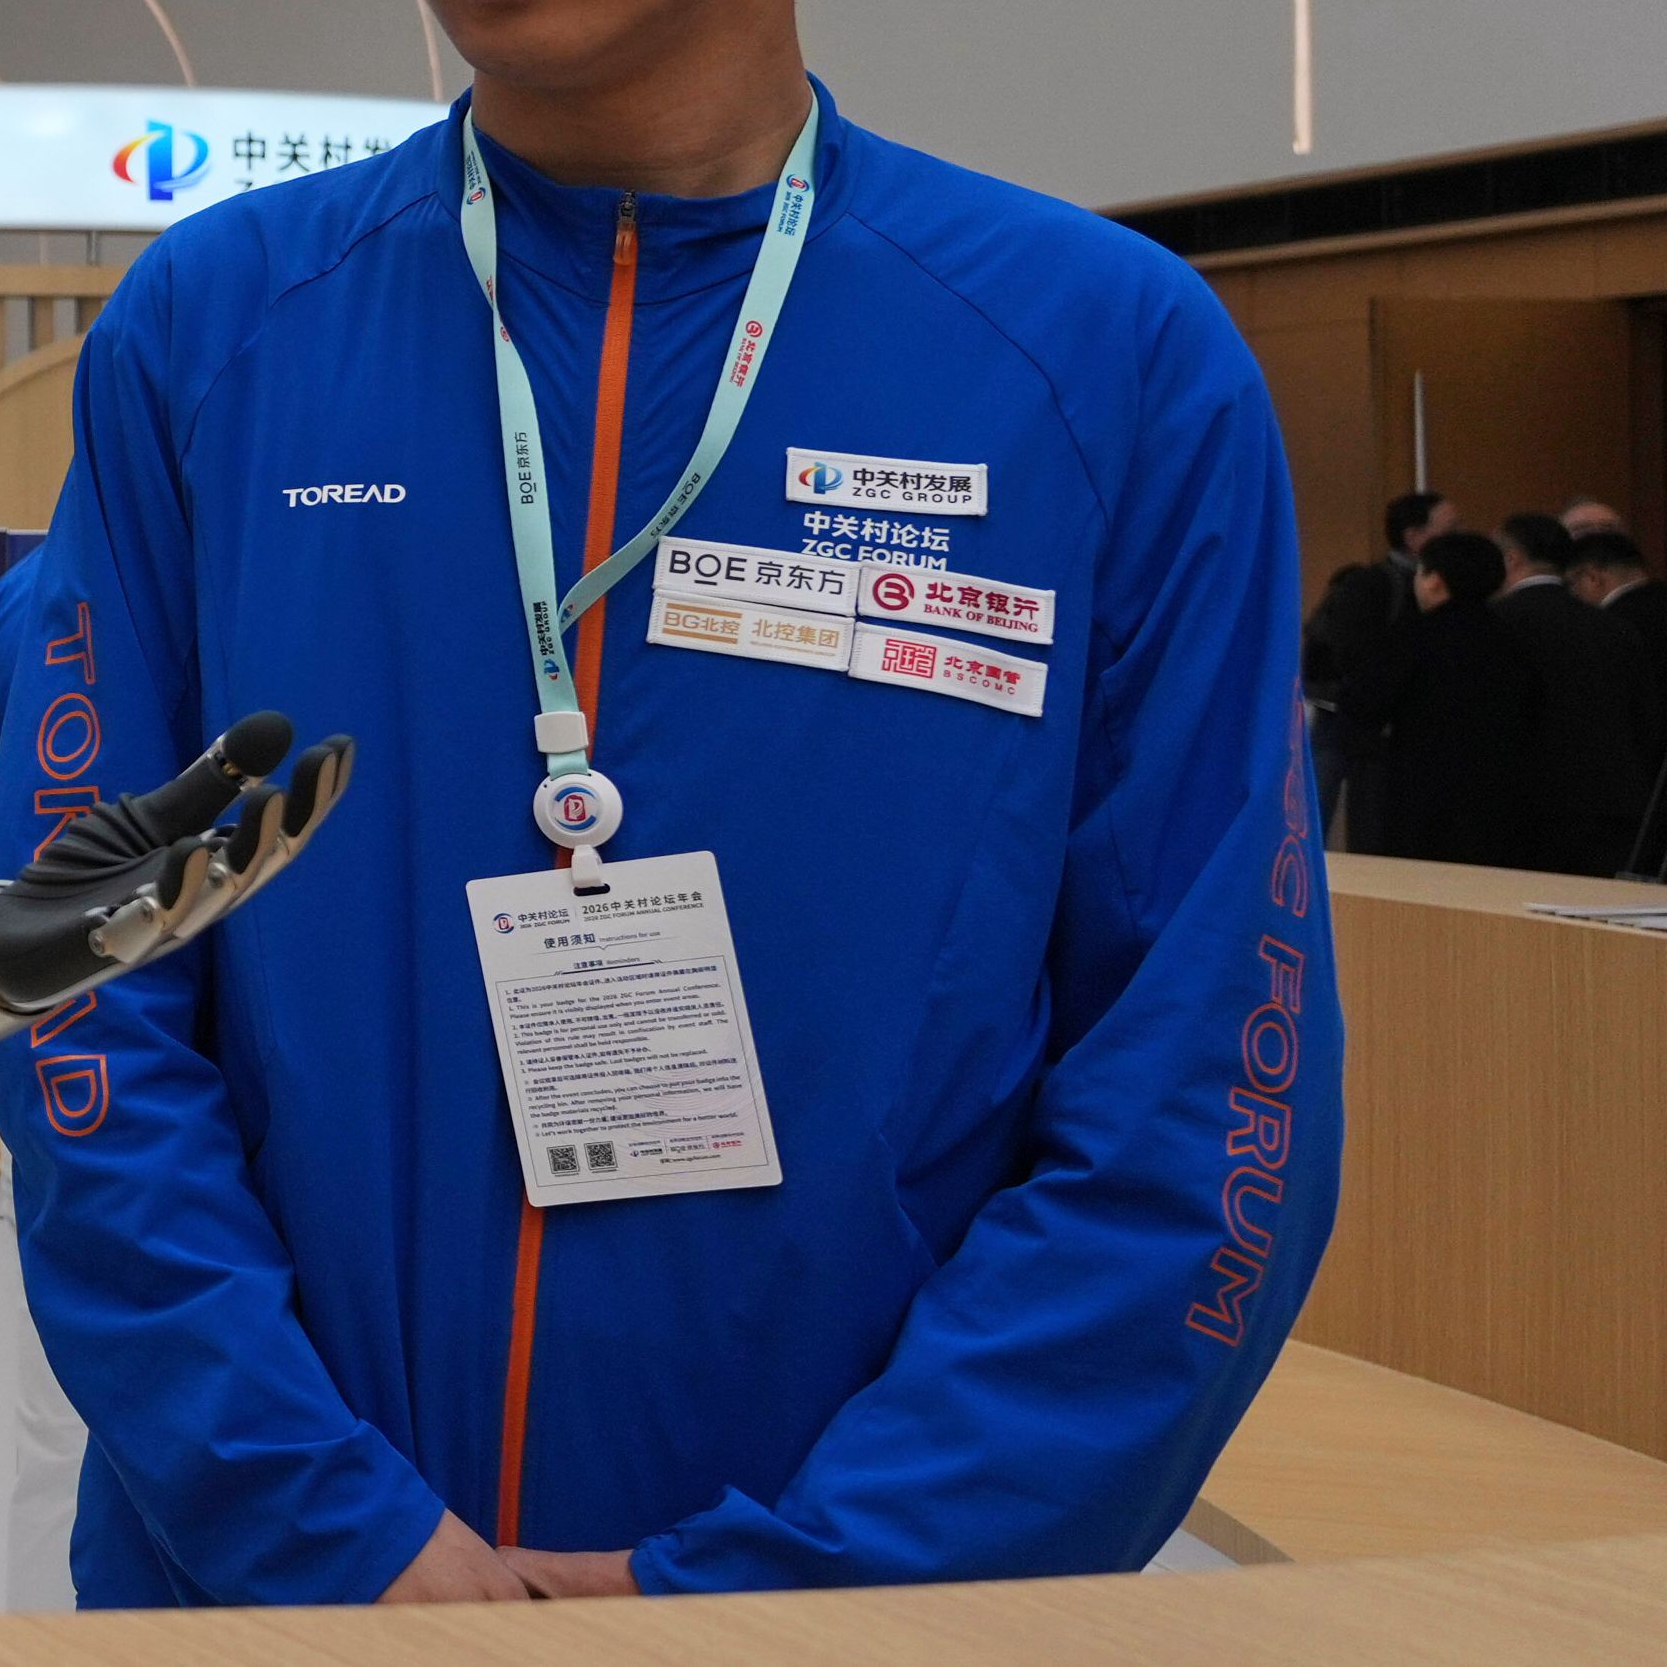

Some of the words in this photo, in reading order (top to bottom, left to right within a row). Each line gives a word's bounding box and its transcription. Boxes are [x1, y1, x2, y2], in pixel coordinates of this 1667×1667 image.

[785, 194, 803, 236] 中关村论坛
[515, 433, 529, 468] 京东方
[283, 484, 405, 507] TOREAD
[518, 472, 537, 504] BOE
[677, 473, 701, 505] BOE
[853, 468, 971, 493] 中关村发展
[853, 487, 891, 499] ZGC
[903, 492, 972, 504] GROUP
[804, 511, 950, 552] 中关村论坛
[801, 539, 852, 559] ZGC
[858, 546, 947, 571] FORUM
[669, 550, 747, 585] BOE
[755, 561, 845, 595] 京东方
[541, 601, 551, 631] GROUP
[926, 582, 1040, 620] 北京银行
[533, 602, 549, 656] 中关村发展
[664, 612, 740, 635] BG北控
[752, 619, 840, 648] 北控集团
[923, 604, 961, 618] BANK
[966, 611, 983, 622] OF
[987, 615, 1038, 632] BEIJING
[517, 909, 569, 923] 中关村论坛
[582, 892, 703, 914] 2026中关村论坛年会
[544, 934, 596, 949] 使用须知
[1185, 935, 1306, 1347] FORUM
